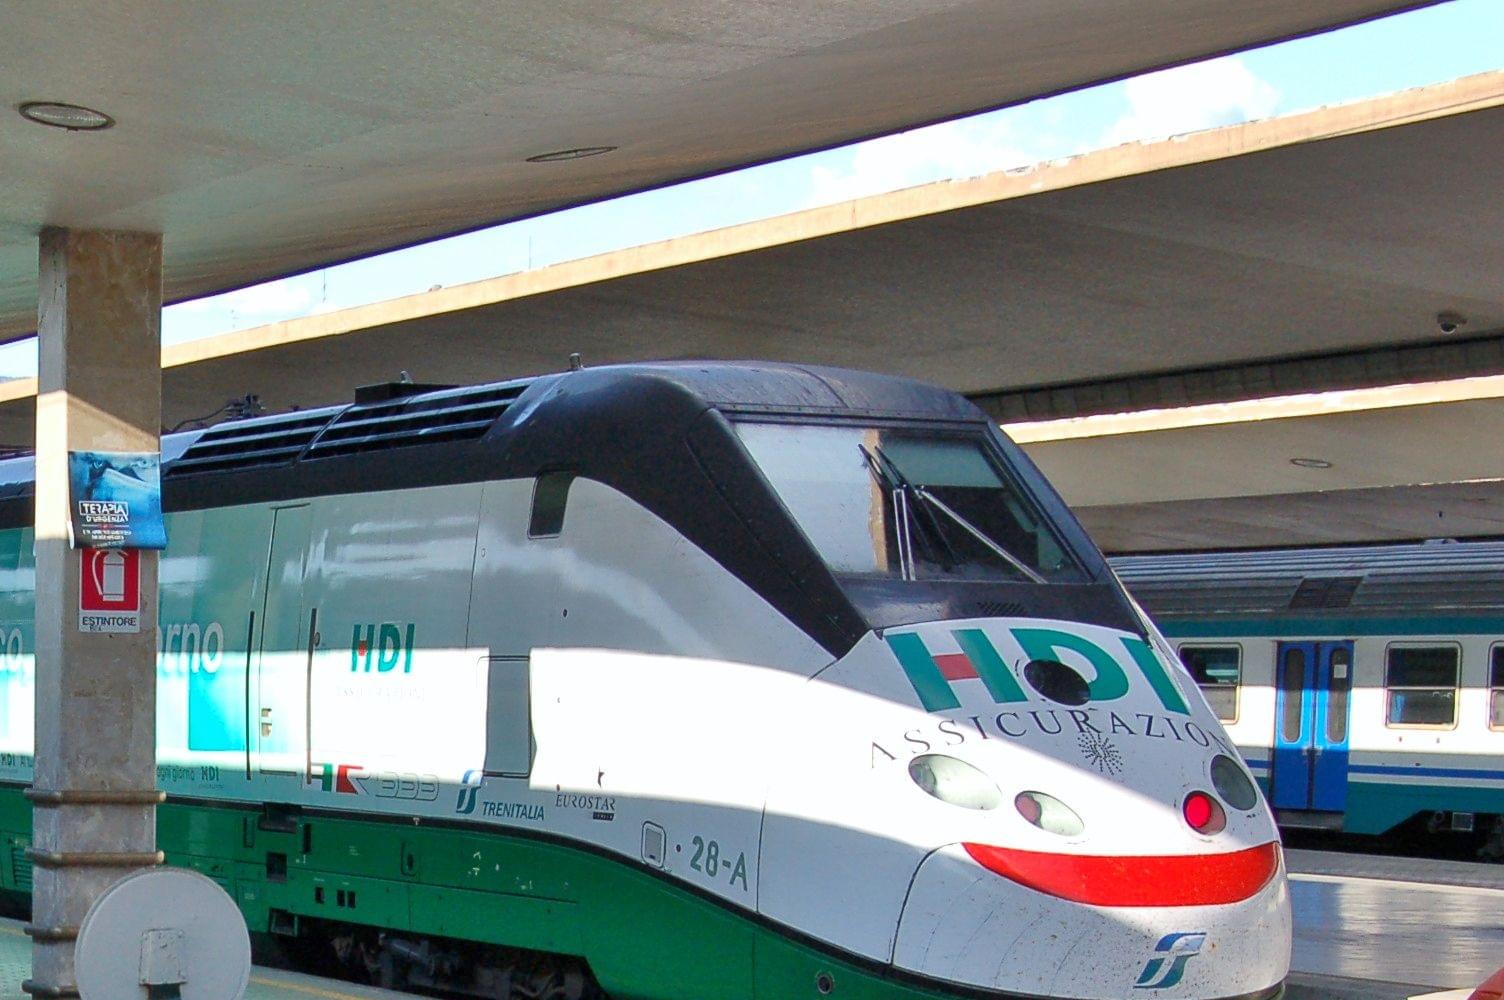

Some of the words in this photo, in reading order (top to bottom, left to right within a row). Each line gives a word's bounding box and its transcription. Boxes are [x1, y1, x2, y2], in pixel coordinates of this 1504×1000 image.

[82, 503, 127, 517] TERAPIA
[82, 616, 137, 627] ESTINTORE
[351, 623, 415, 673] HDI
[884, 628, 1191, 716] HDI
[201, 766, 219, 781] HDI
[482, 801, 545, 820] TRENITALIA
[555, 794, 616, 811] EUROSTAR
[690, 835, 748, 891] 28-A
